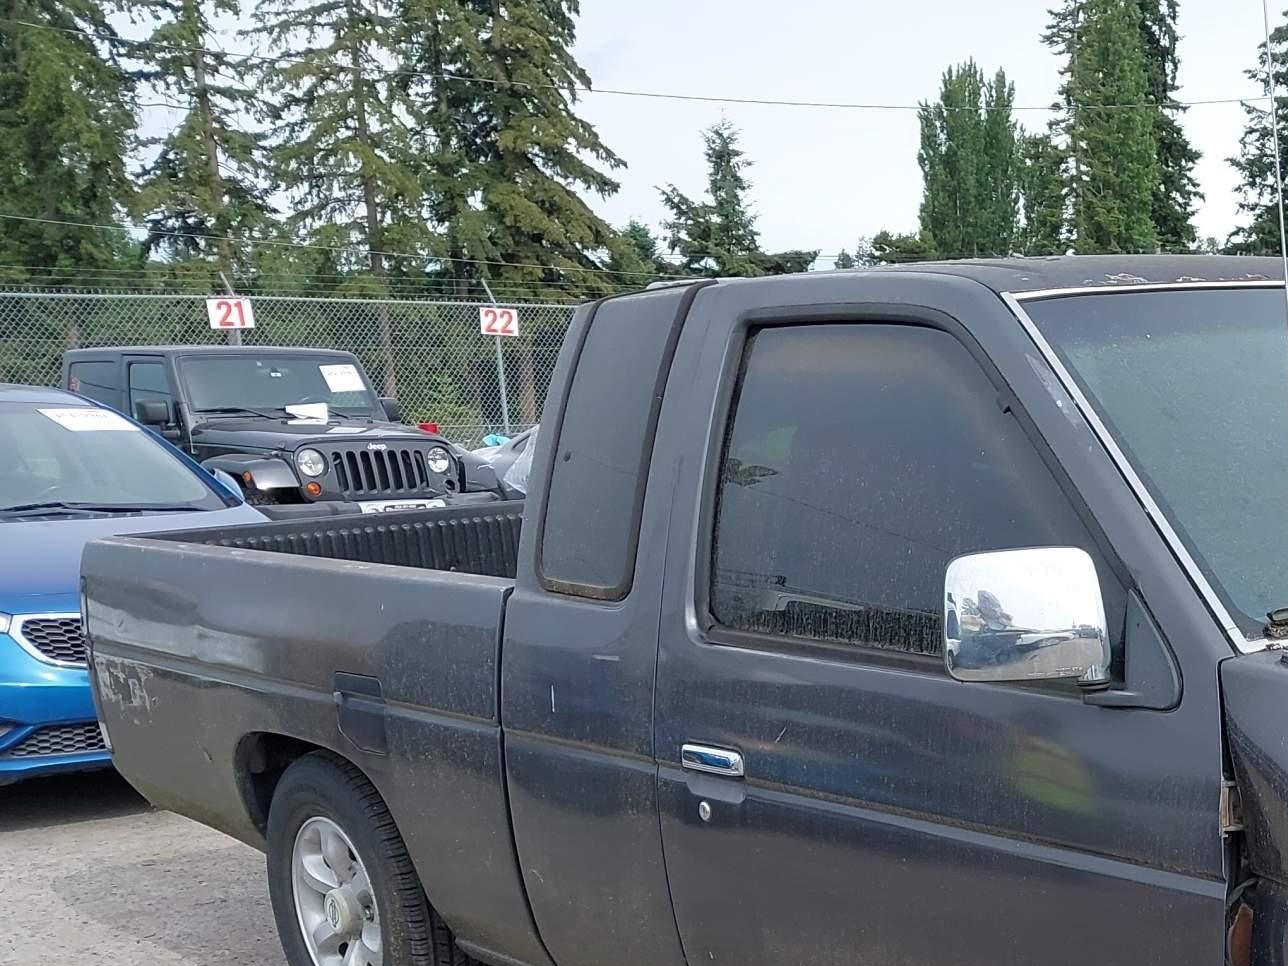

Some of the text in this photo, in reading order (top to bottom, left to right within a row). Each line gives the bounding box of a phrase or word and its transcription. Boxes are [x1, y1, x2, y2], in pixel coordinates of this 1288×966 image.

[216, 300, 246, 327] 21
[484, 309, 514, 334] 22
[367, 442, 388, 451] Jeep
